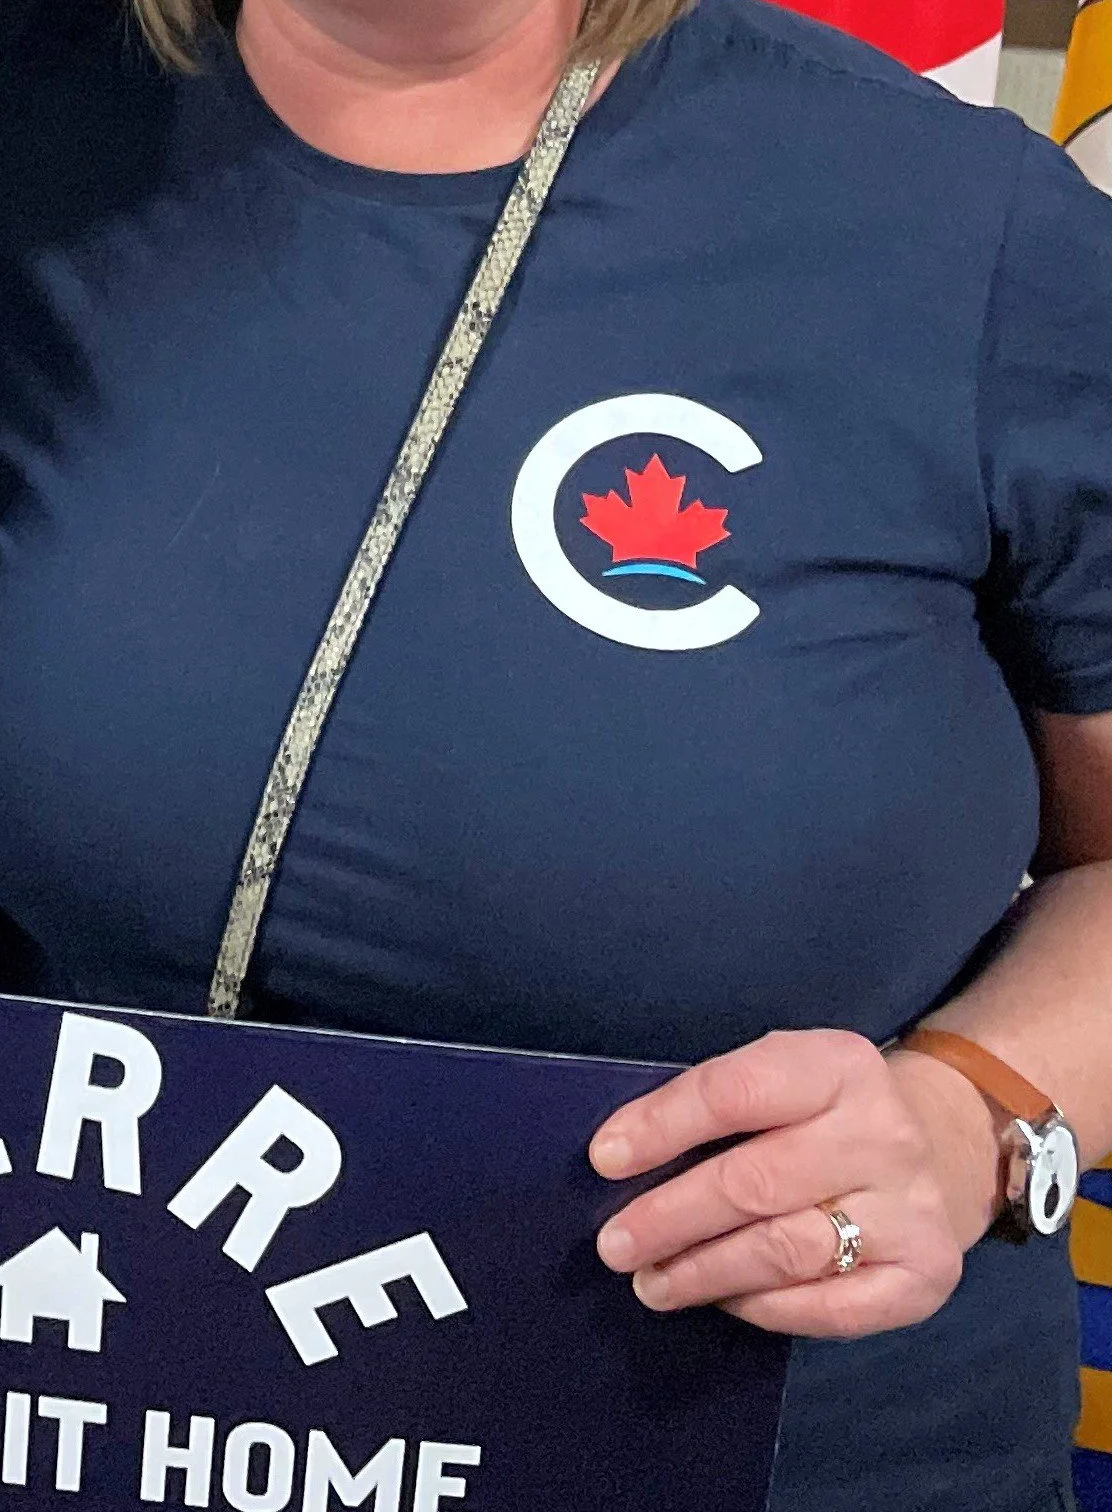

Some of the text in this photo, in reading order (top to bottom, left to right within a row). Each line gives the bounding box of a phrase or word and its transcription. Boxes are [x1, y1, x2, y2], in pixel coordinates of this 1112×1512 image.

[511, 393, 763, 651] C
[1, 1390, 108, 1493] IT
[139, 1409, 482, 1512] HOME
